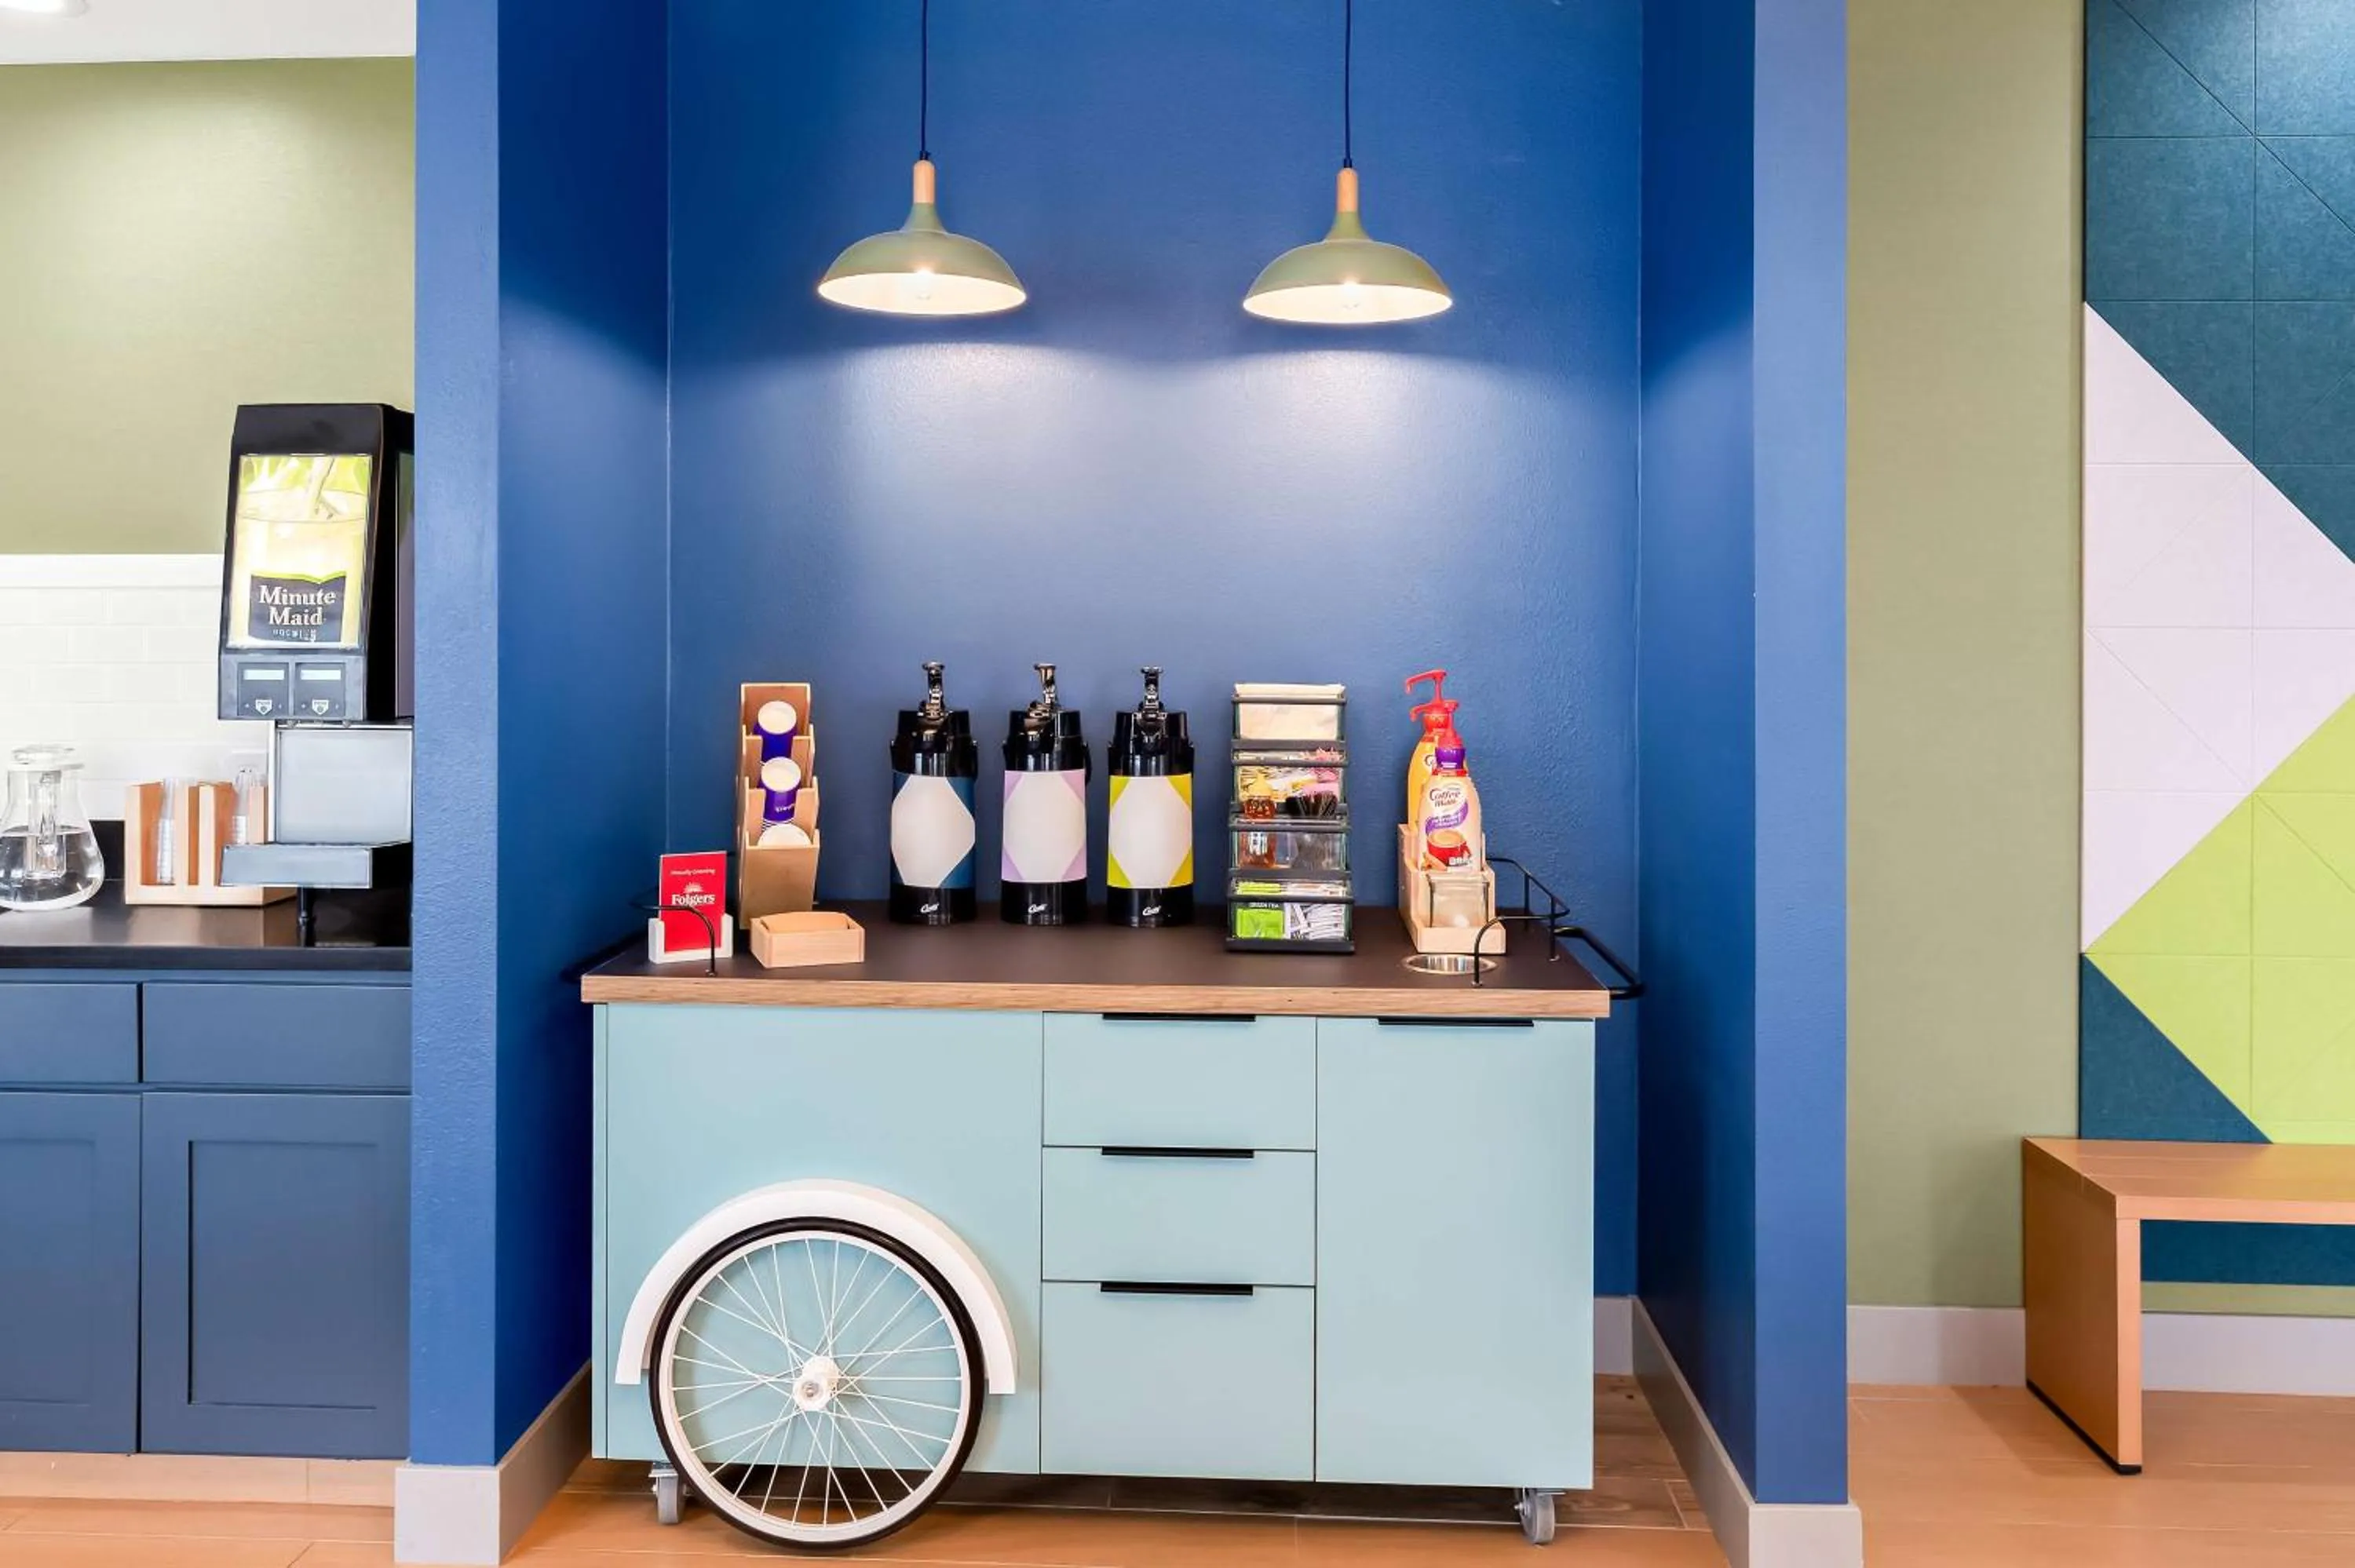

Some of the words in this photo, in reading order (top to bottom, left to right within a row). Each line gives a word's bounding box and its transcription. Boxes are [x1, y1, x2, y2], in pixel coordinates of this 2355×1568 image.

[258, 585, 336, 605] Minute
[269, 607, 323, 625] Maid
[672, 894, 716, 908] Folgers
